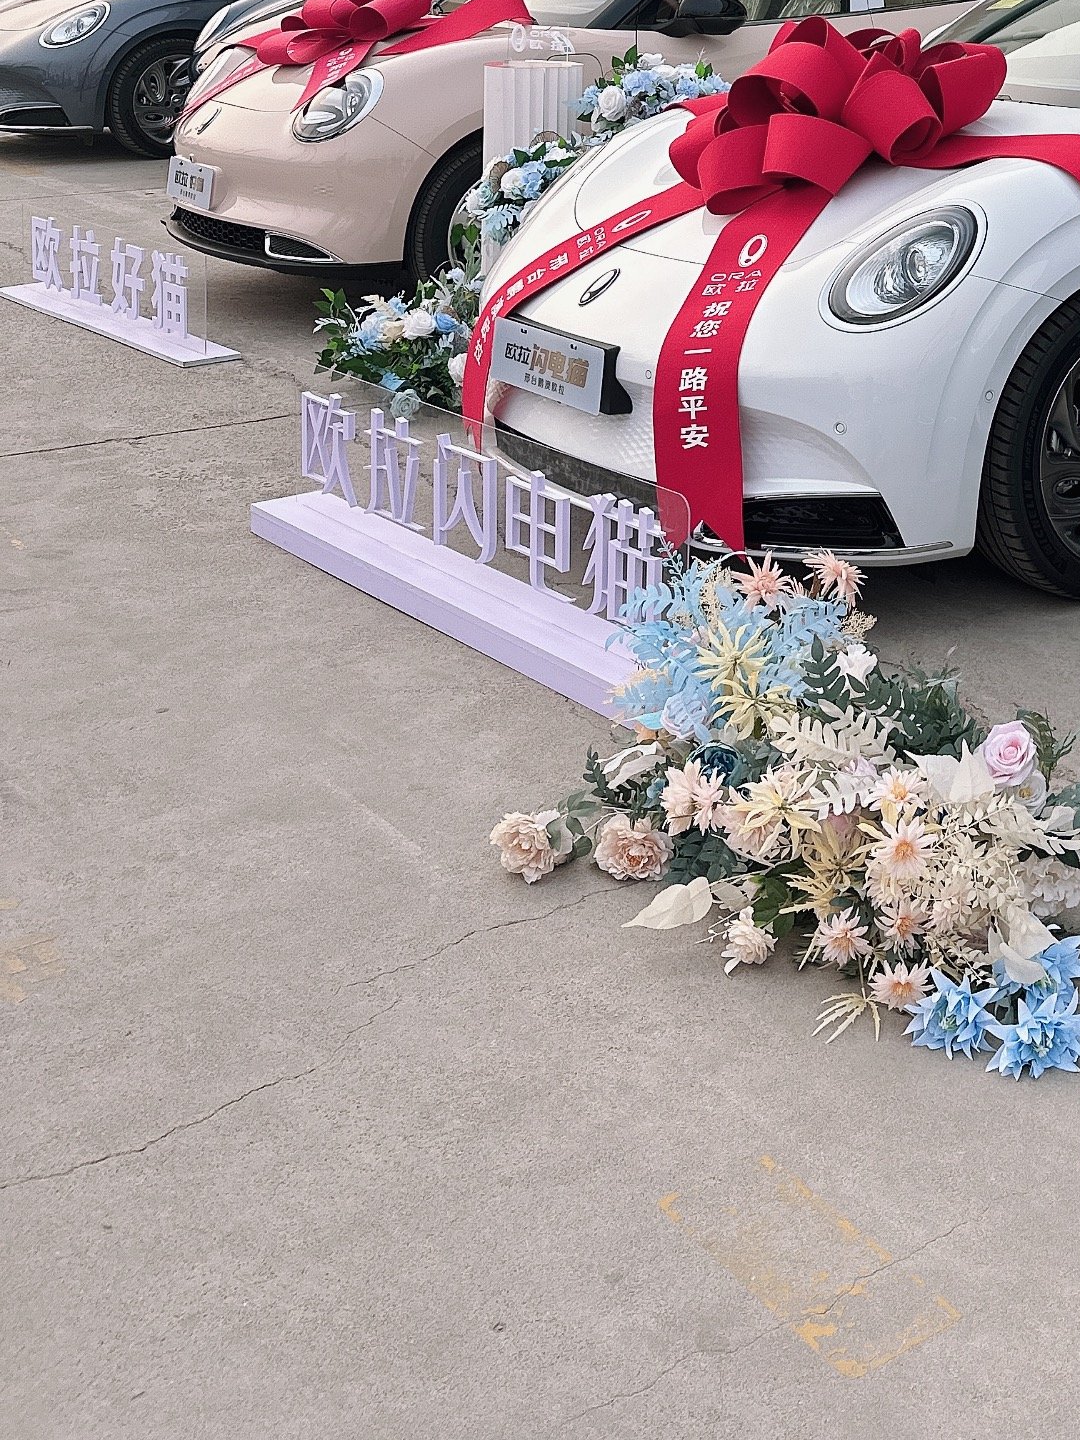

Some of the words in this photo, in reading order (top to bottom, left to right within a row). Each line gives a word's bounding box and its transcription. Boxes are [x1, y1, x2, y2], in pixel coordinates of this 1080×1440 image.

[31, 215, 188, 339] 欧拉好猫
[702, 279, 759, 296] 欧拉
[710, 270, 762, 282] ORA
[678, 300, 733, 450] 祝您一路平安
[301, 391, 667, 627] 欧拉闪电猫
